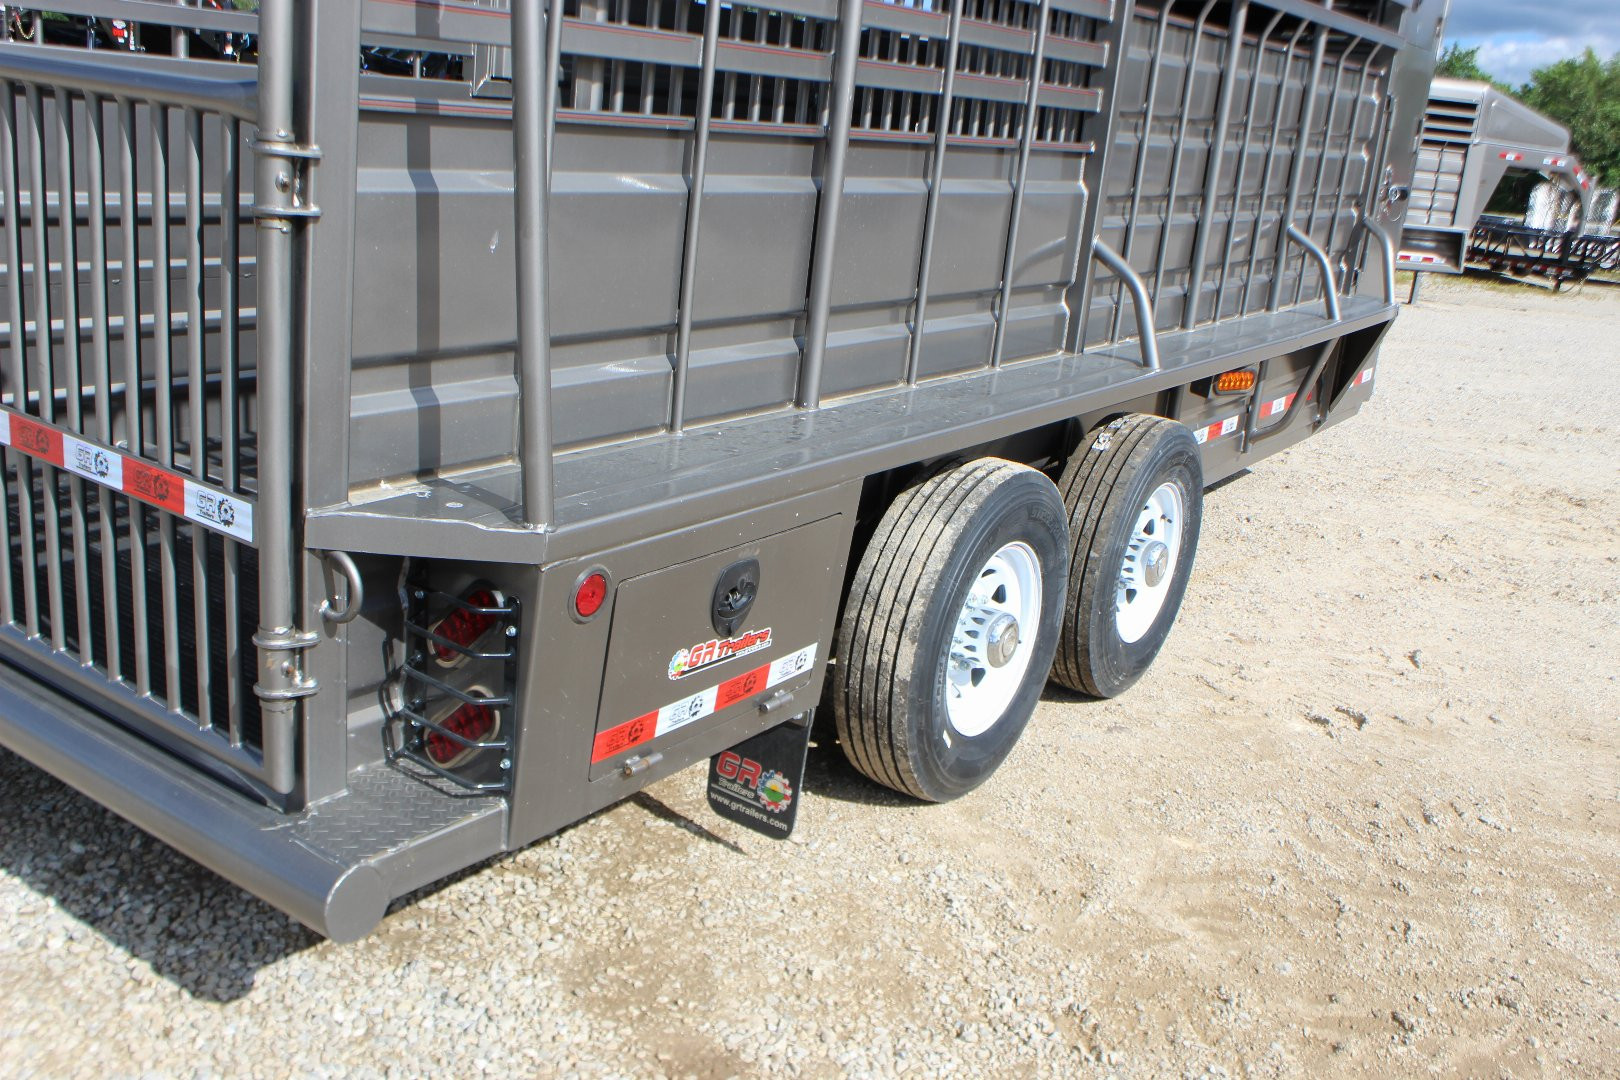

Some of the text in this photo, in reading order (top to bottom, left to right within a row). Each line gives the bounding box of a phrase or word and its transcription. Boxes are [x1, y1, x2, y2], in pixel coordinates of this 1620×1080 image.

[196, 489, 216, 514] GR
[199, 508, 215, 520] Trailers
[687, 640, 717, 668] GR
[717, 629, 771, 657] Trailers
[716, 750, 762, 790] GR
[718, 777, 755, 799] Trailers
[710, 791, 788, 831] www.grtrailers.com
